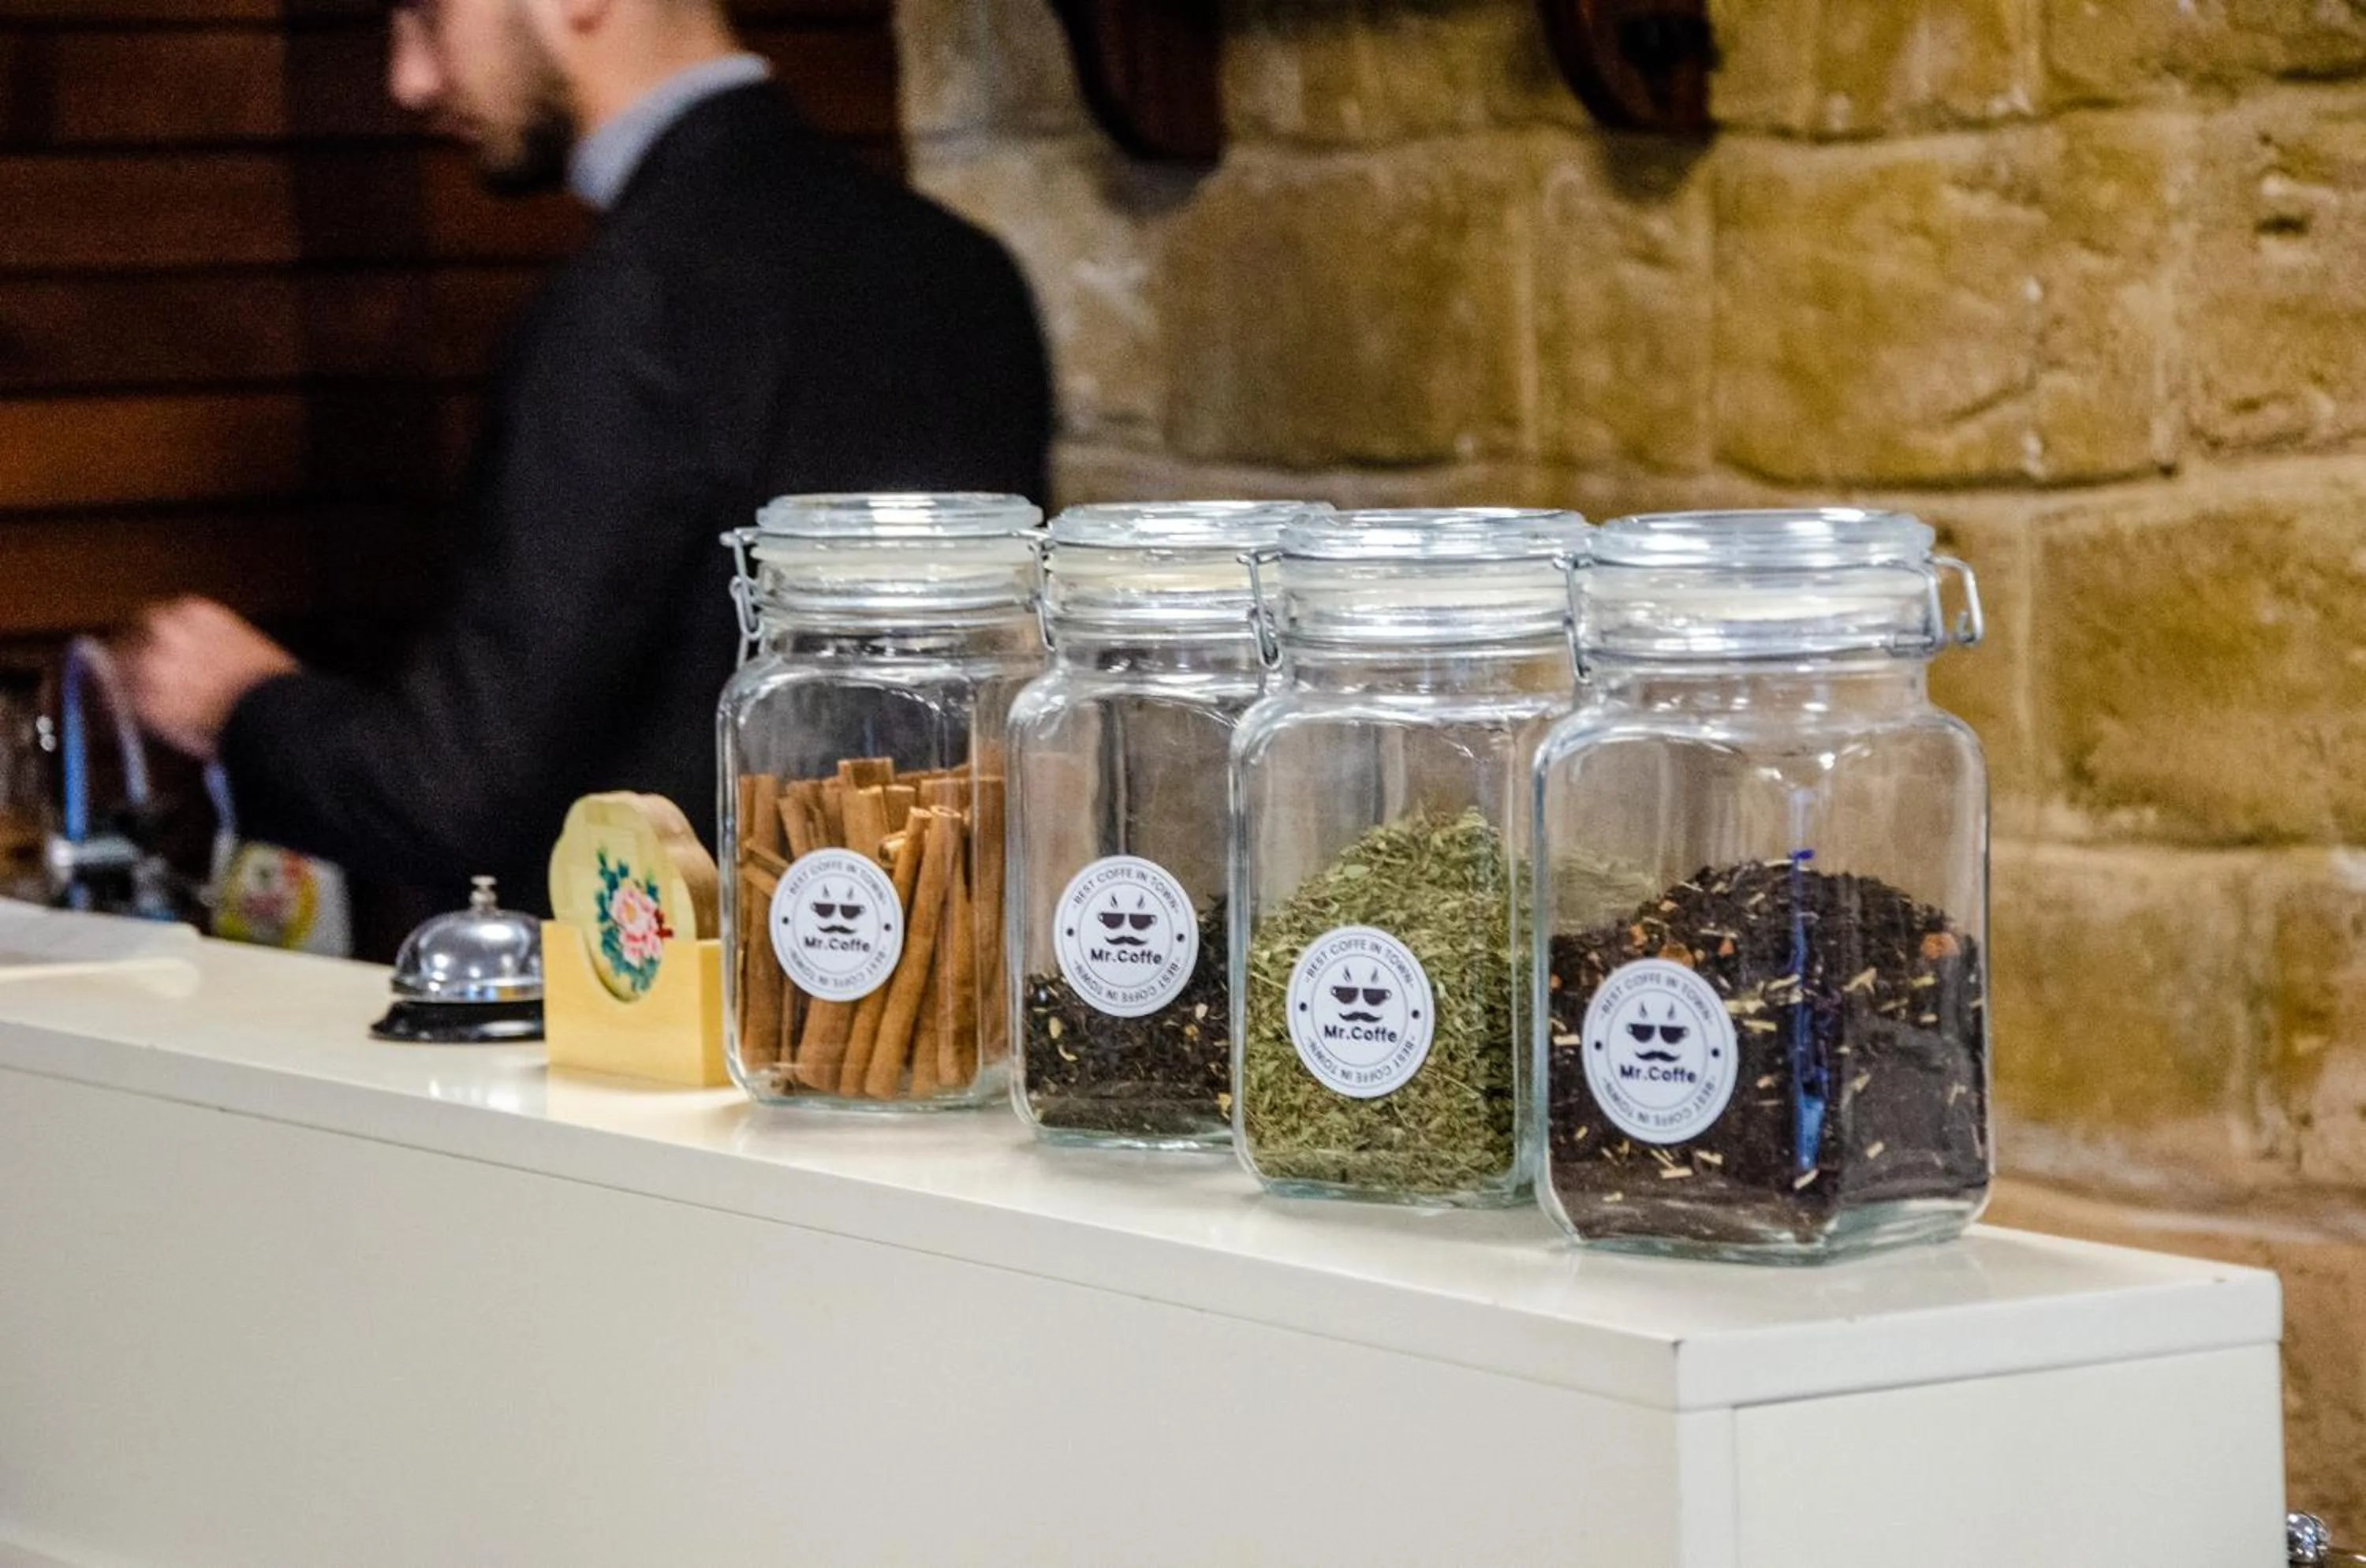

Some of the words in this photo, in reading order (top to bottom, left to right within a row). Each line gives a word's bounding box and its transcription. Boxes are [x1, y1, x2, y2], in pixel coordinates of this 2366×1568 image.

[1136, 869, 1149, 882] IN
[1369, 942, 1383, 954] IN
[1091, 949, 1162, 964] Mr.Coffe
[1106, 989, 1118, 1001] IN
[1324, 1025, 1398, 1043] Mr.Coffe
[1340, 1068, 1353, 1081] IN
[1621, 1066, 1696, 1082] Mr.Coffe
